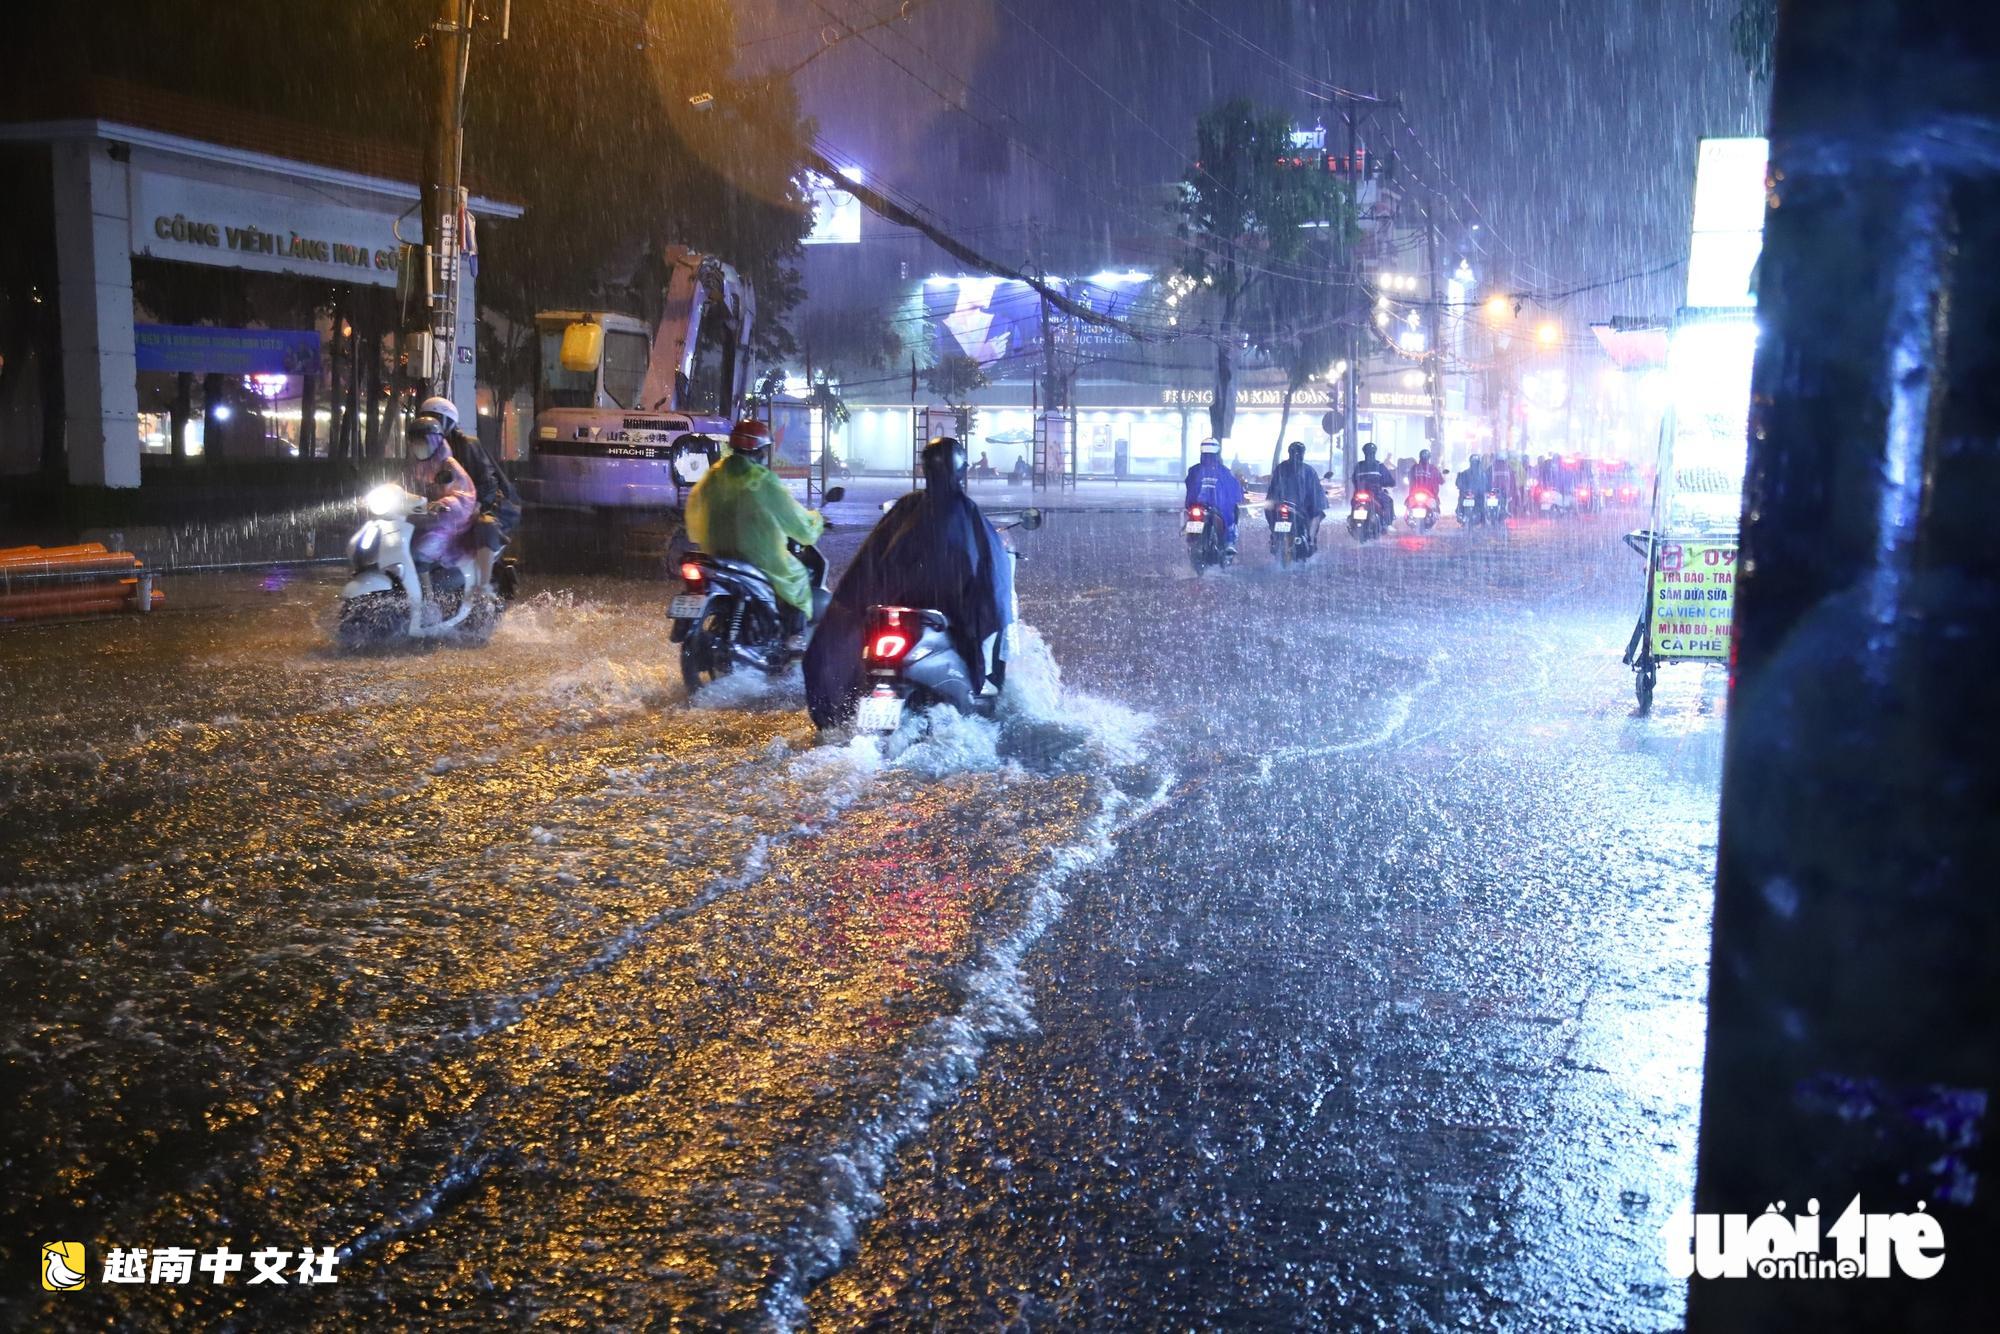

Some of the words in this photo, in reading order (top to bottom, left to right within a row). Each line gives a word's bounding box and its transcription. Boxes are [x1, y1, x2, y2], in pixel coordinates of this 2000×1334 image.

[155, 213, 219, 247] CÔNG
[225, 224, 273, 254] VIÊN
[276, 230, 329, 263] LÀNG
[333, 242, 370, 267] HOA
[608, 448, 644, 456] HITACHI
[1705, 549, 1737, 566] 09
[1712, 570, 1732, 583] TRÀ
[1689, 637, 1722, 651] PHÊ
